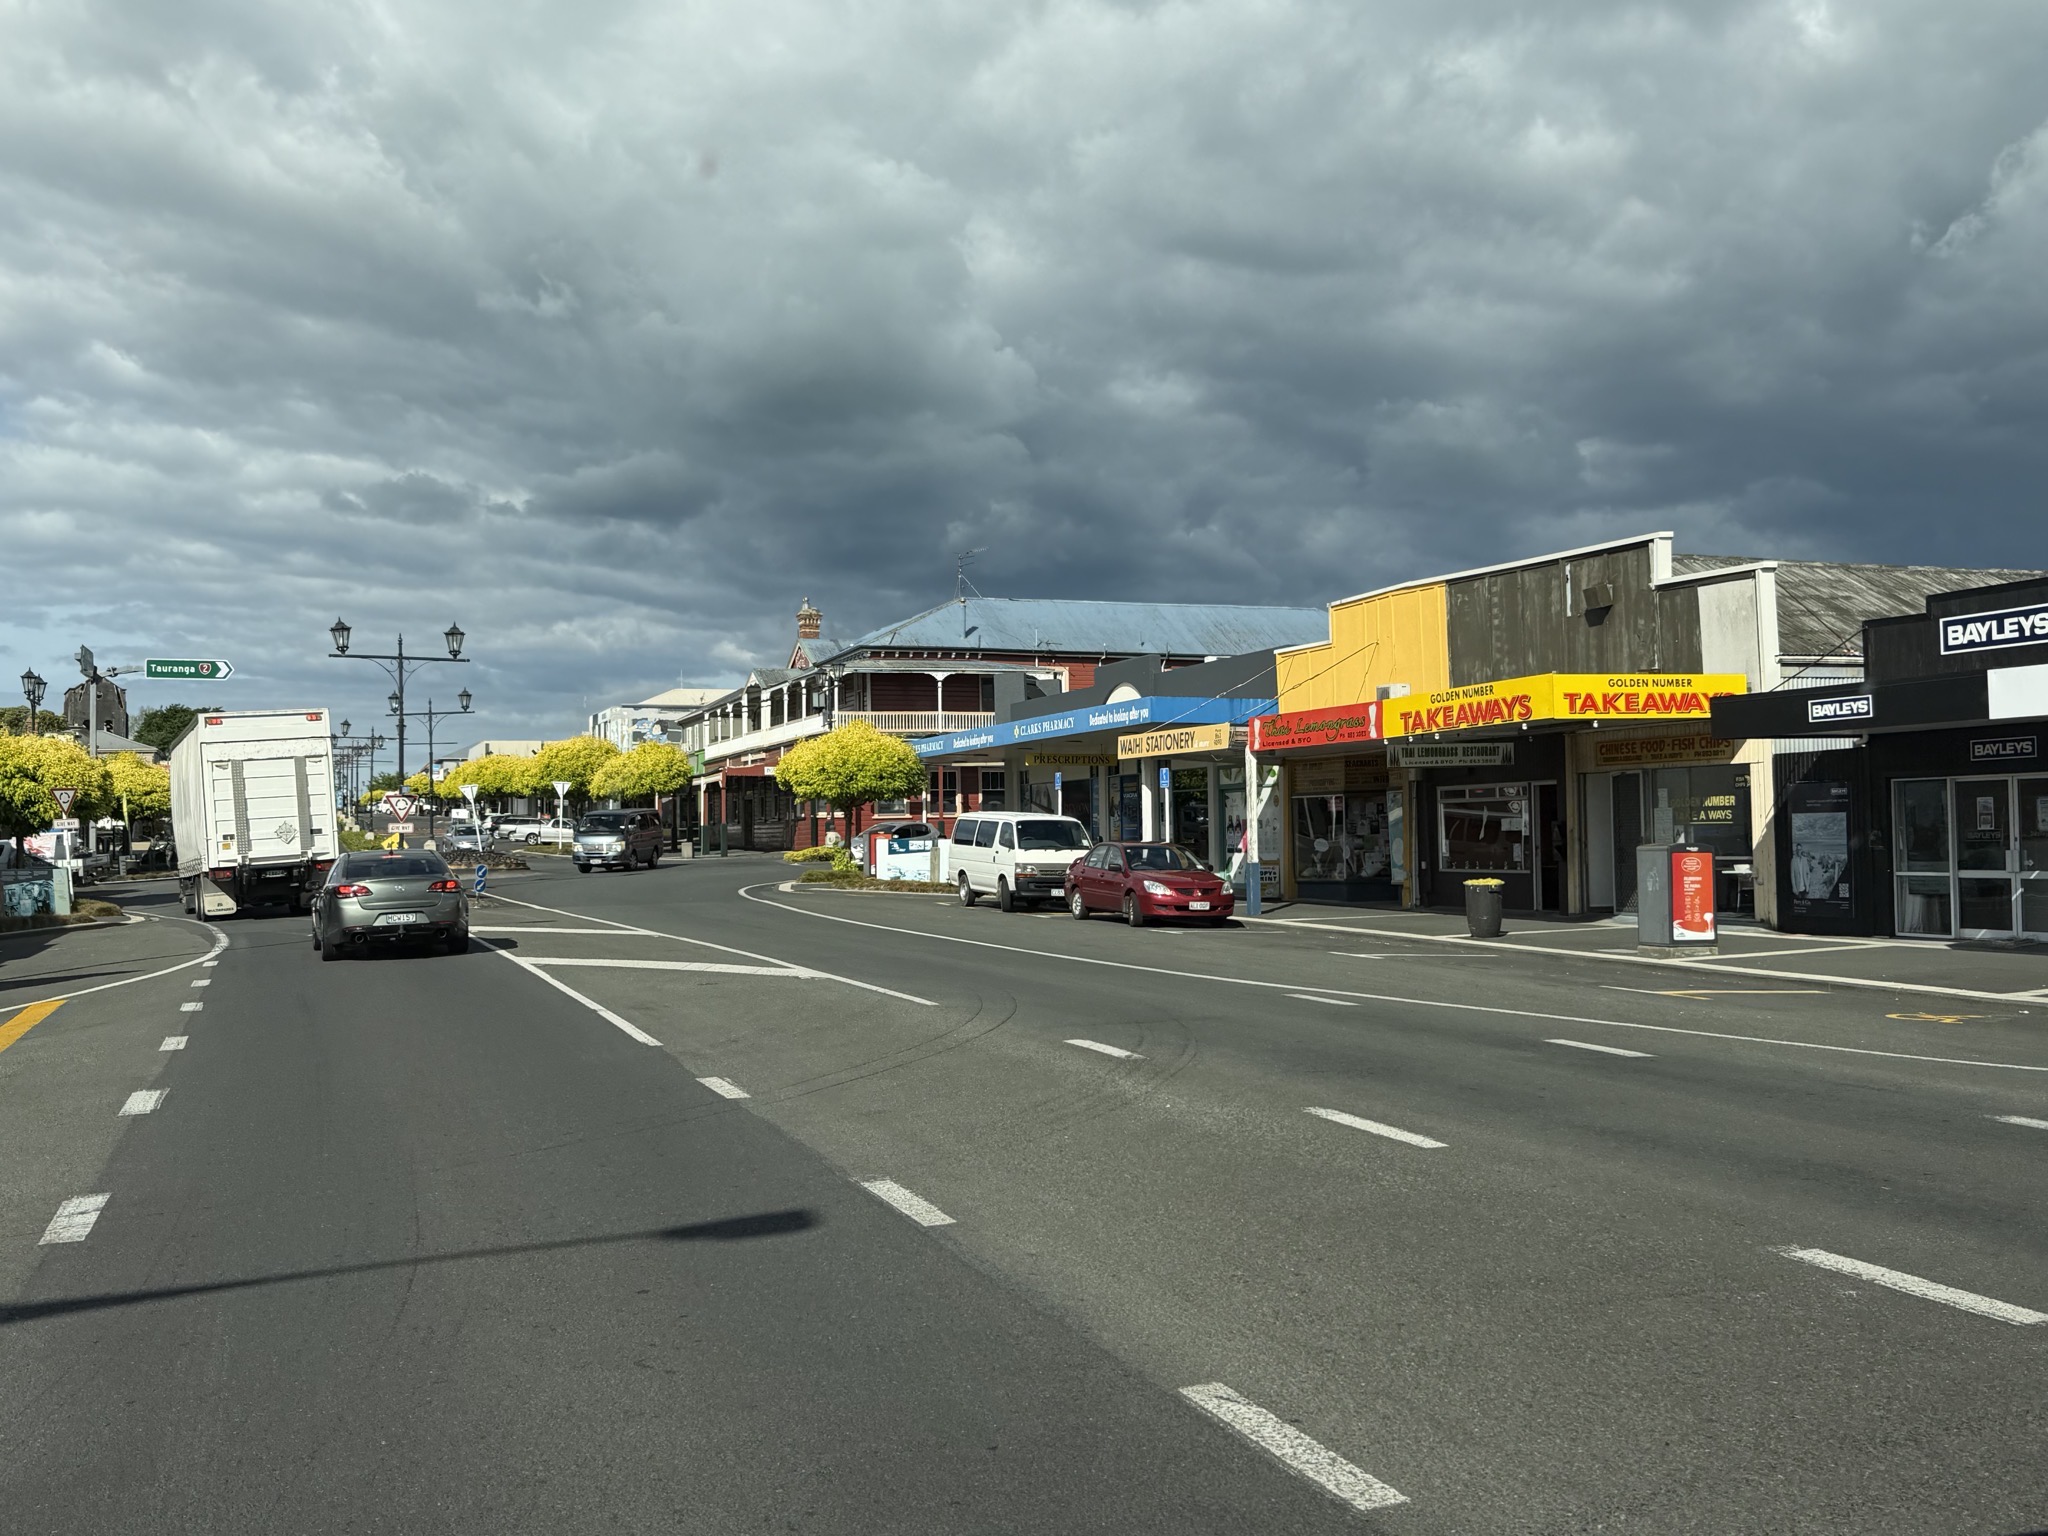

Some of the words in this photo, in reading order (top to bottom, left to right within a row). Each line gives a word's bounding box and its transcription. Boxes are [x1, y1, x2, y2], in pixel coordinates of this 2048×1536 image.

[1947, 612, 2048, 646] BAYLEYS
[150, 664, 195, 675] Tauranga
[202, 664, 208, 673] 2
[1608, 679, 1649, 688] GOLDEN
[1652, 678, 1693, 688] NUMBER
[1430, 690, 1460, 704] GOLDEN
[1463, 685, 1494, 699] NUMBER
[1563, 692, 1736, 714] TAKEAWA
[1089, 711, 1108, 727] Dedicated
[1108, 711, 1113, 724] to
[1114, 708, 1129, 725] looking
[1140, 708, 1149, 722] you
[1400, 694, 1533, 734] TAKEAWAYS
[1812, 700, 1869, 718] BAYLEYS
[1020, 722, 1041, 736] CLARKS
[1042, 717, 1075, 733] PHARMACY
[1263, 714, 1292, 738] Thai
[1294, 716, 1366, 741] Lemongrass
[1120, 738, 1143, 756] WAIHI
[1146, 731, 1196, 753] STATIONERY
[1262, 739, 1289, 747] Licensed
[1401, 747, 1415, 758] THAI
[1417, 746, 1459, 758] LEMONGRASS
[1462, 745, 1500, 757] RESTAURANT
[1600, 741, 1637, 756] CHINESE
[1640, 739, 1666, 753] FOOD
[1671, 738, 1695, 751] FISH
[1699, 737, 1731, 749] CHIPS
[1974, 741, 2033, 757] BAYLEYS
[1034, 754, 1110, 764] PRESCRIPTIONS
[1703, 795, 1736, 807] NUMBER
[1699, 811, 1706, 820] A
[1708, 810, 1732, 820] WAYS
[1967, 831, 2001, 839] BAYLEYS
